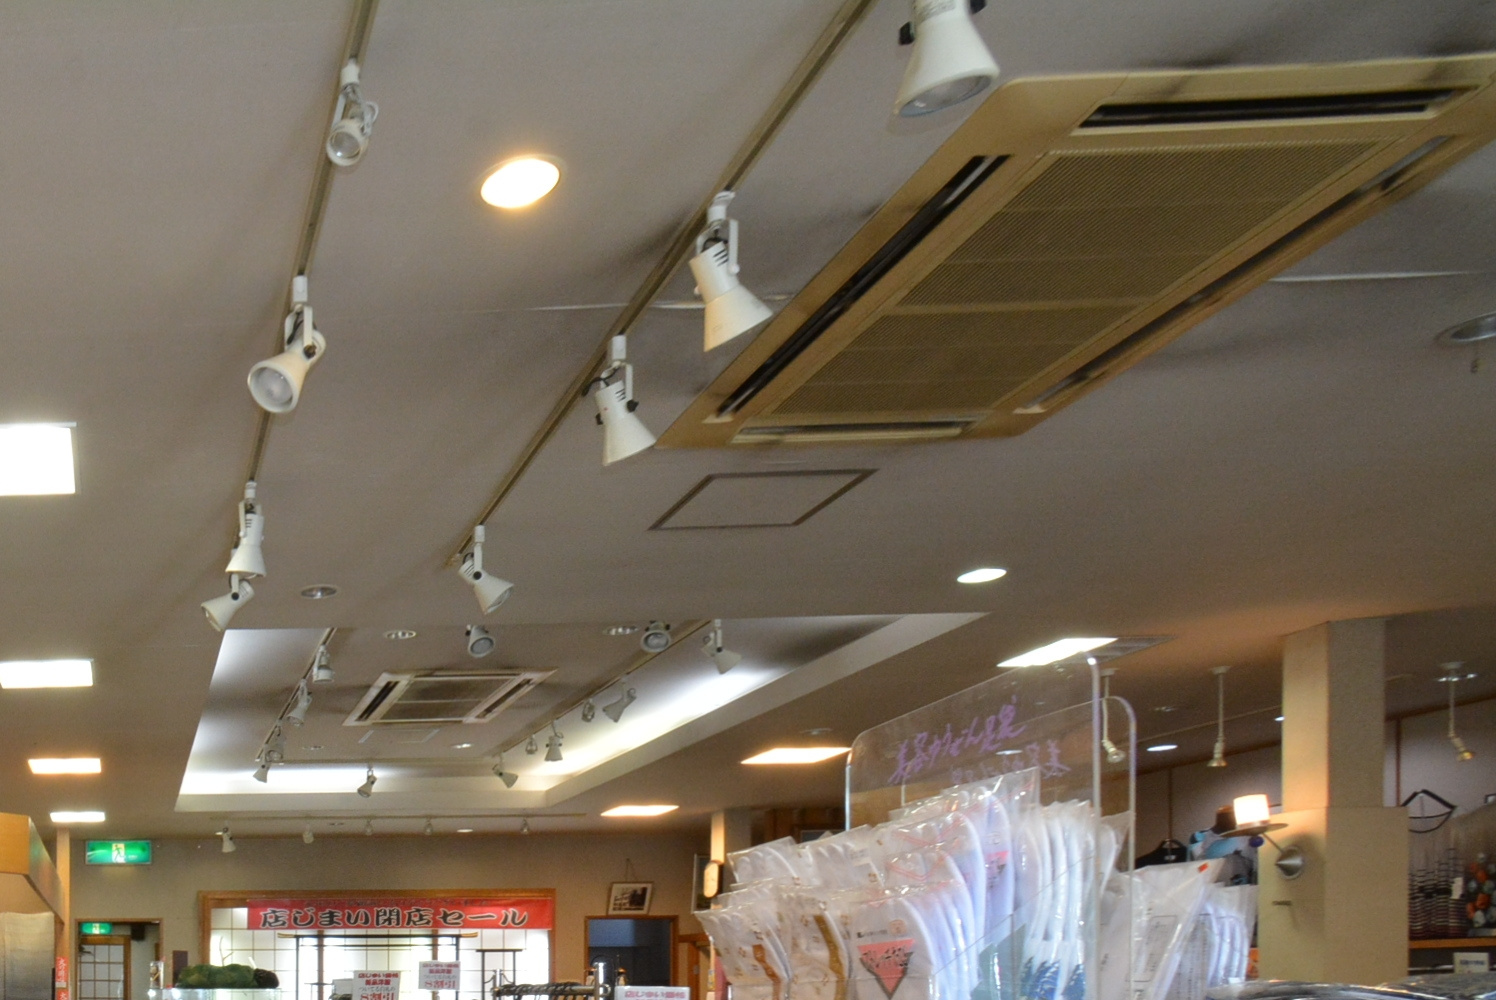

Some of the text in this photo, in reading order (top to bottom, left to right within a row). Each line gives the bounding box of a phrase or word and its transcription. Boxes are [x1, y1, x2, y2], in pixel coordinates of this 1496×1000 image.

[260, 907, 528, 928] 店じまい閉店セール
[425, 980, 456, 988] 8割引
